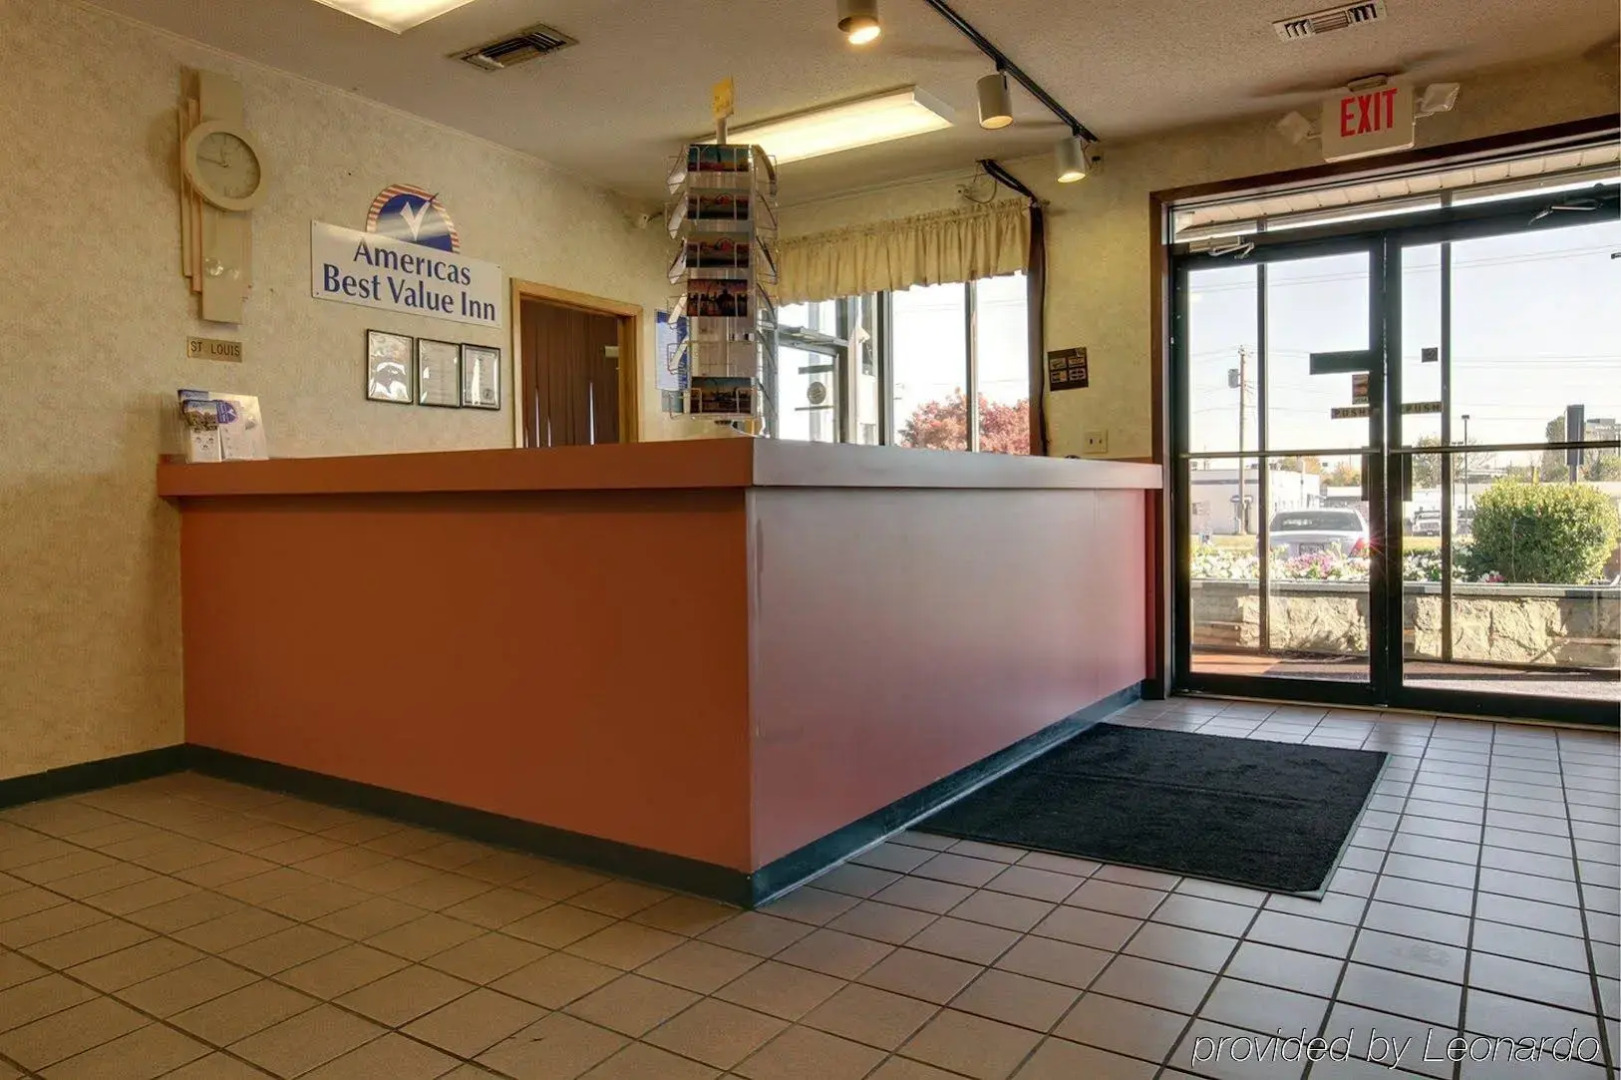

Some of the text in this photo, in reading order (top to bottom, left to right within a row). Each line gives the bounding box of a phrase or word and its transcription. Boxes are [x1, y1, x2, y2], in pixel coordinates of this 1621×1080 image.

[1340, 87, 1398, 137] EXIT
[353, 238, 471, 286] Americas
[323, 263, 496, 321] Best Value Inn
[190, 340, 240, 356] ST LOUIS
[1334, 408, 1368, 418] PUSH
[1405, 402, 1441, 412] PUSH
